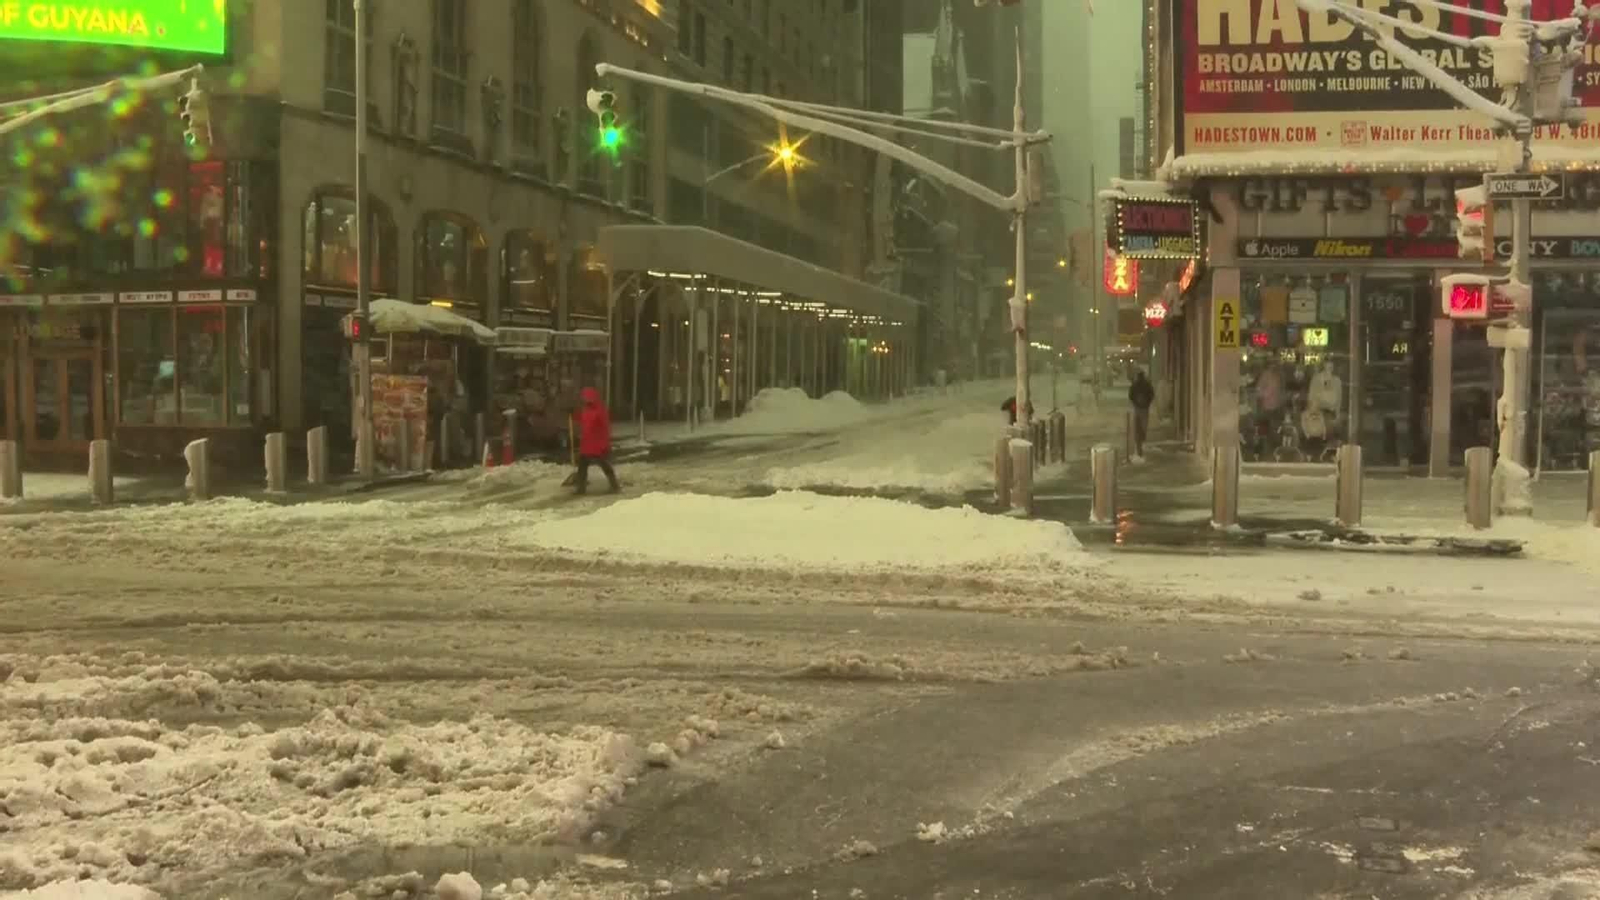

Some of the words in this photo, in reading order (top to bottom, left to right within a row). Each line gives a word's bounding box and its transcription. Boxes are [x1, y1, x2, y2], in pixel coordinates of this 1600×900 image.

[0, 3, 19, 26] F
[28, 5, 148, 36] GUYANA
[1199, 51, 1362, 73] BROADWAY'S
[1200, 79, 1263, 93] AMSTERDAM
[1274, 78, 1316, 92] LONDON
[1327, 77, 1390, 91] MELBOURNE
[1402, 77, 1425, 90] NEW
[1194, 126, 1317, 143] HADESTOWN.COM
[1370, 125, 1415, 141] Walter
[1421, 125, 1451, 140] Kerr
[1240, 176, 1373, 212] GIFTS
[1495, 182, 1517, 191] ONE
[1527, 180, 1551, 191] WAY
[1262, 243, 1299, 257] Apple
[1314, 240, 1372, 257] Nikon
[1220, 302, 1234, 343] ATM
